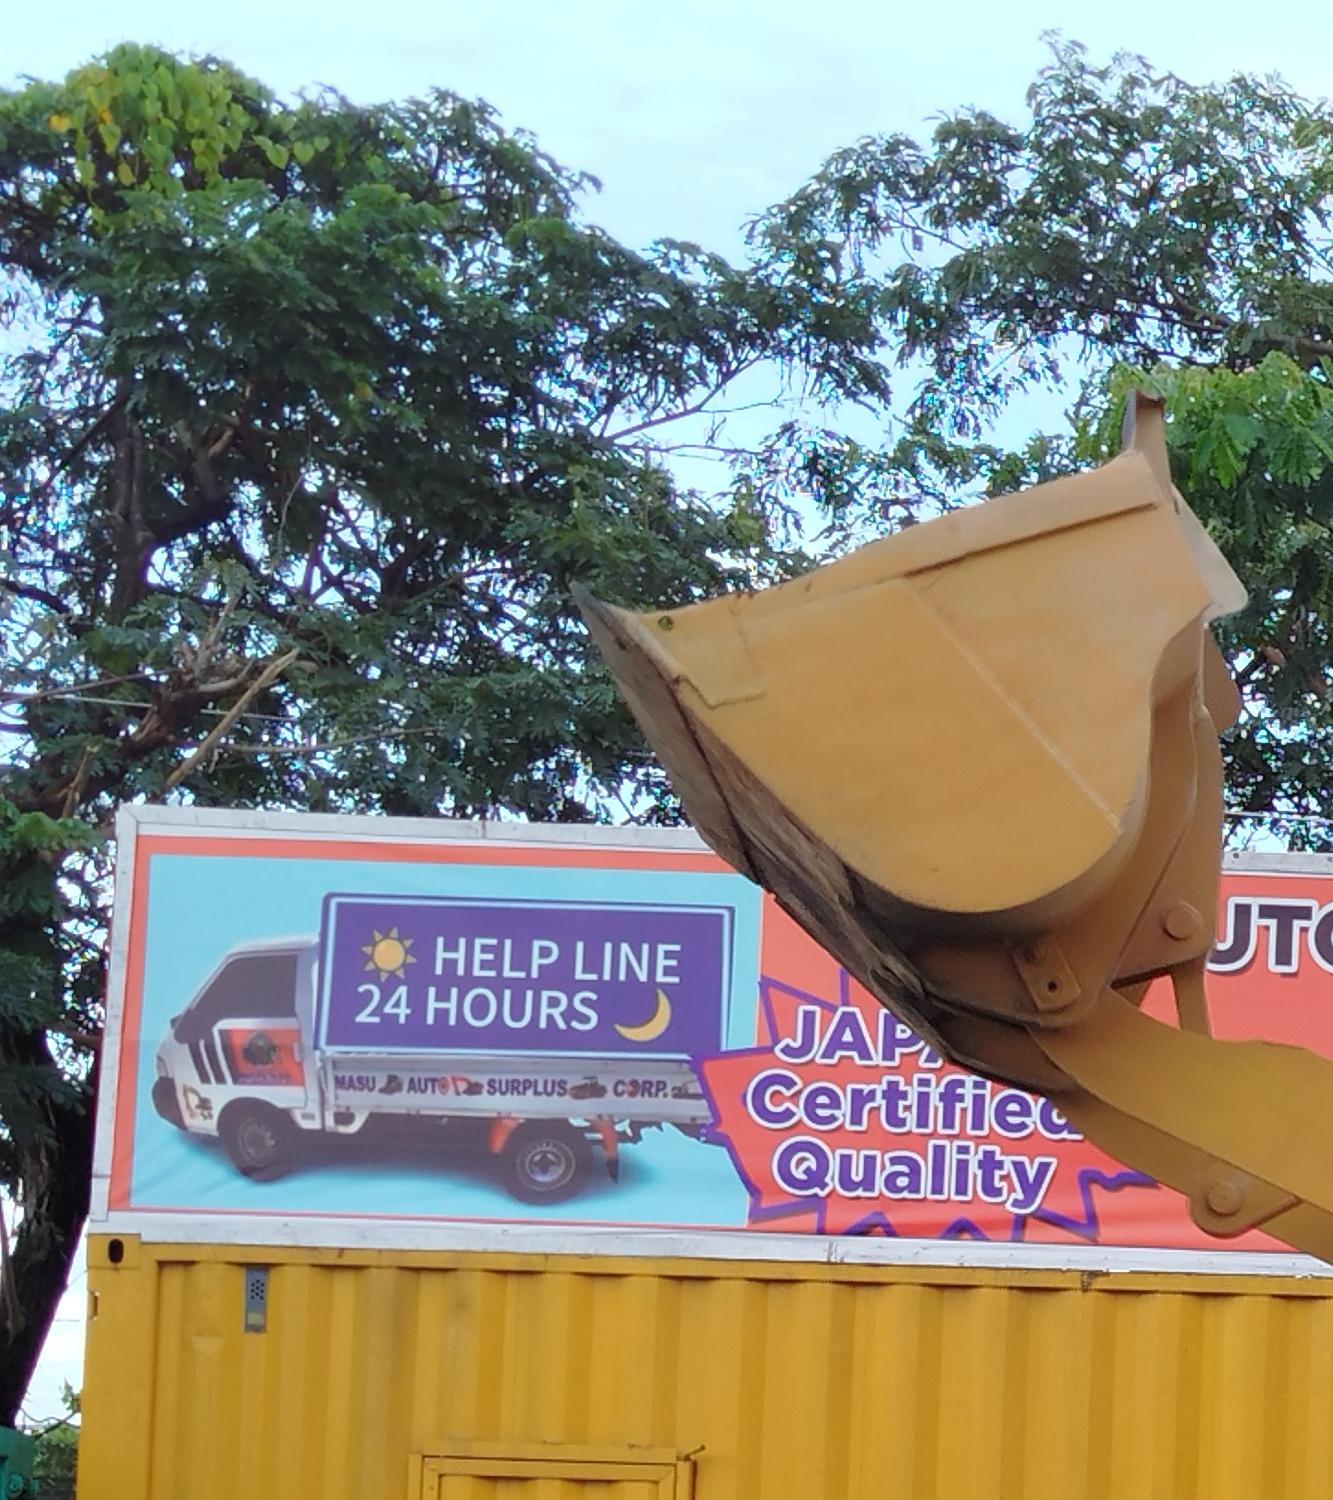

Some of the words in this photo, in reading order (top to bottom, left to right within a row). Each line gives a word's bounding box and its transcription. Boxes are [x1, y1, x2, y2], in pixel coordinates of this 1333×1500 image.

[434, 936, 560, 979] HELP
[574, 940, 682, 984] LINE
[354, 983, 411, 1025] 24
[426, 985, 599, 1031] HOURS
[778, 1008, 940, 1062] JAP
[334, 1074, 377, 1092] MASU
[486, 1077, 568, 1098] SURPLUS
[776, 1140, 1054, 1209] Quality
